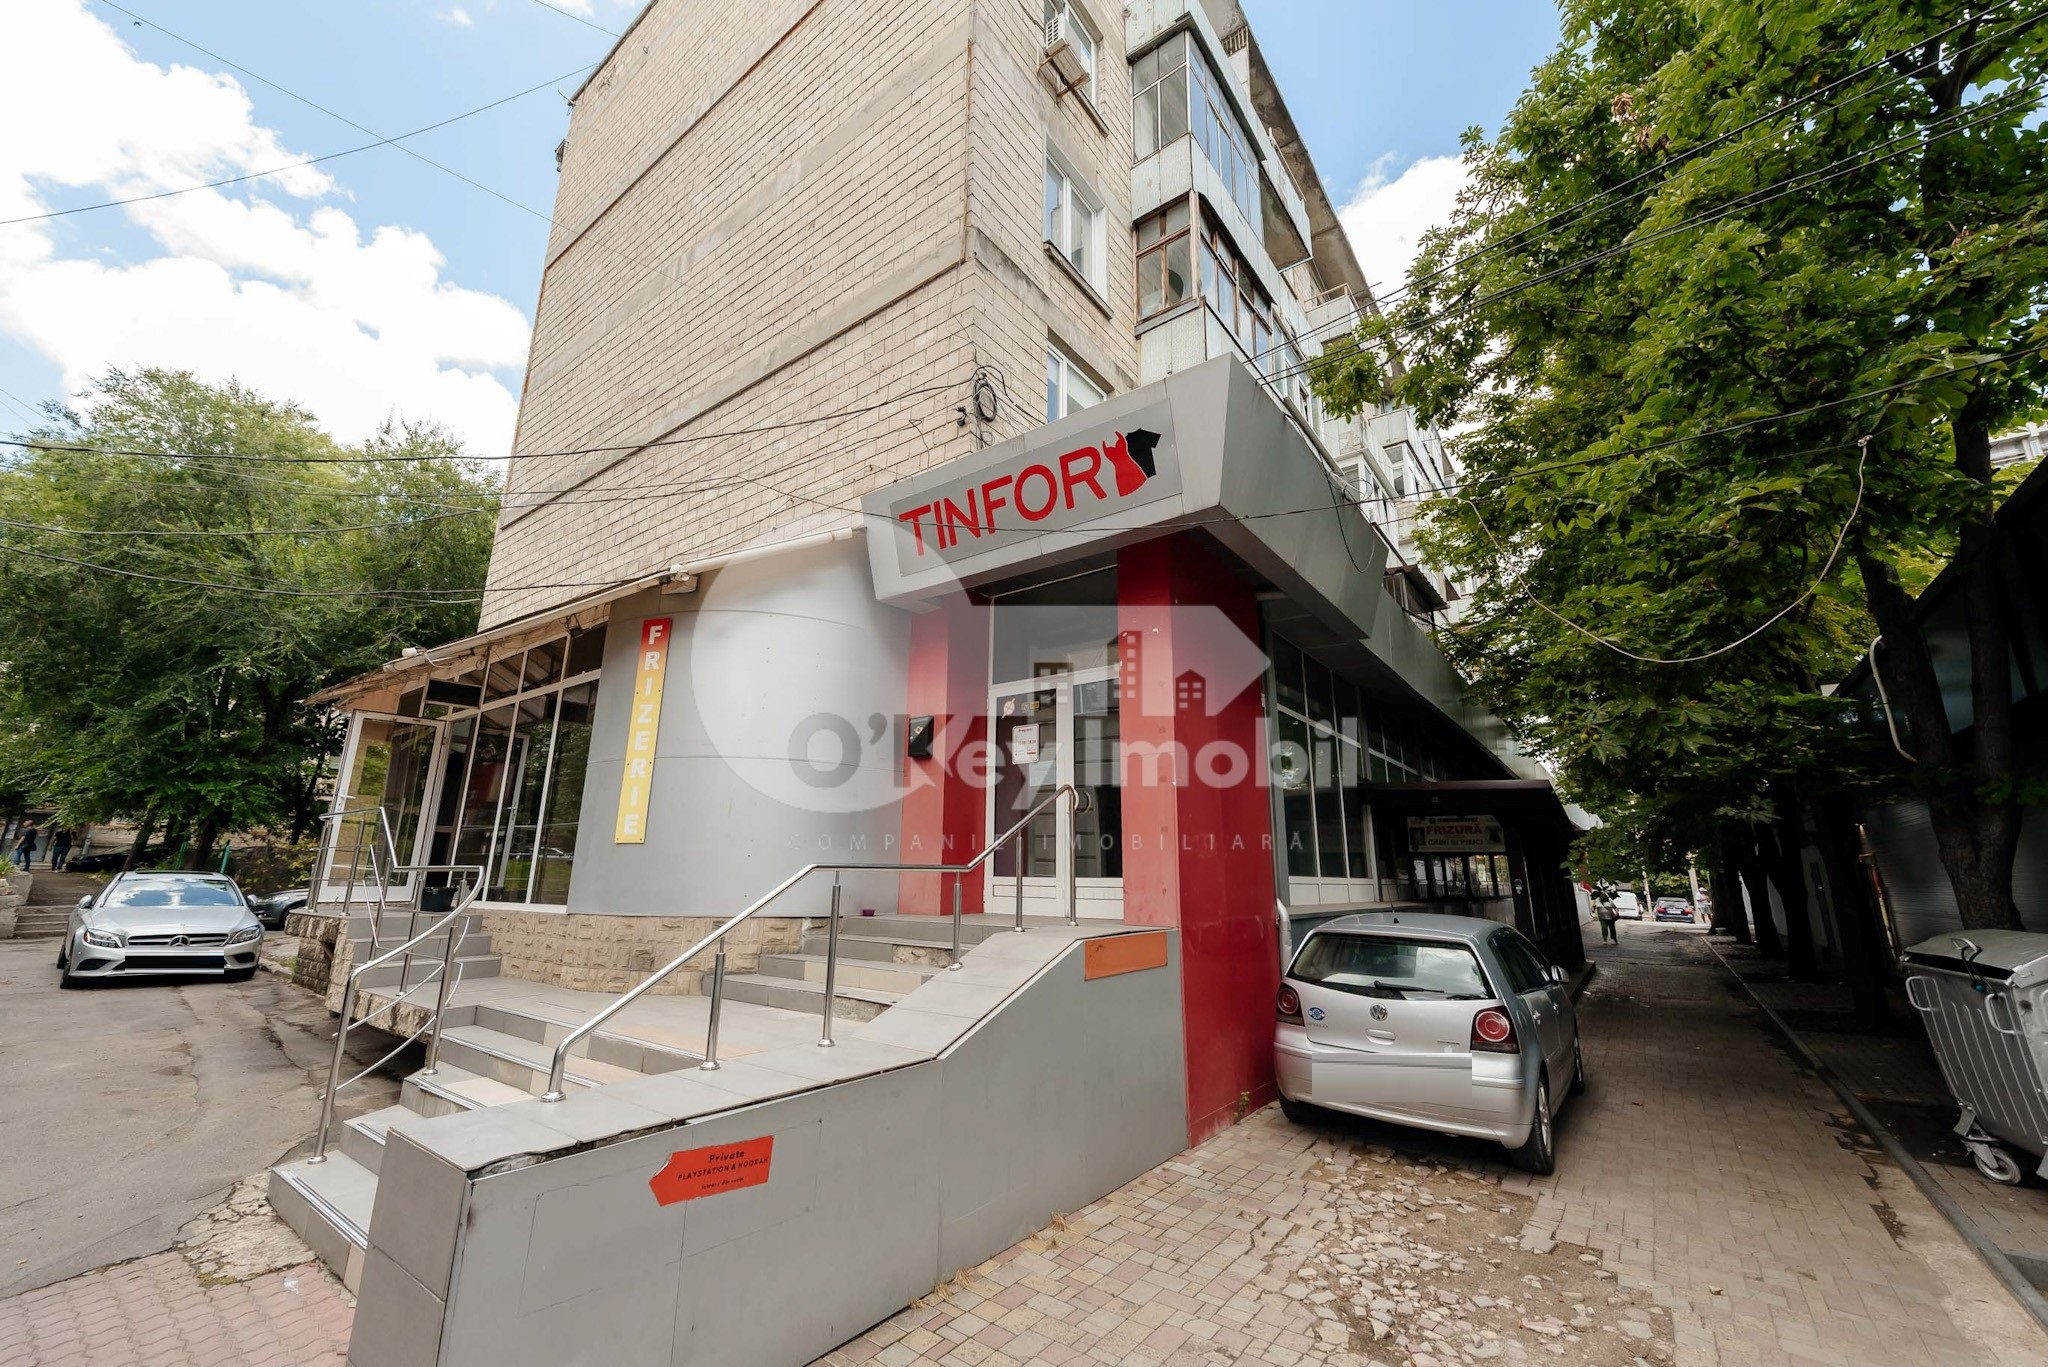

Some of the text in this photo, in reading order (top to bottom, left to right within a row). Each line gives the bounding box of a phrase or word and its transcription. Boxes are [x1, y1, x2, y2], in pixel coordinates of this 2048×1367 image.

[623, 624, 663, 836] FRIZERIE
[1425, 823, 1483, 835] FRIZURĂ
[708, 1150, 745, 1163] Private
[677, 1165, 730, 1181] PLAYSTATION
[738, 1157, 769, 1169] HOOKAH
